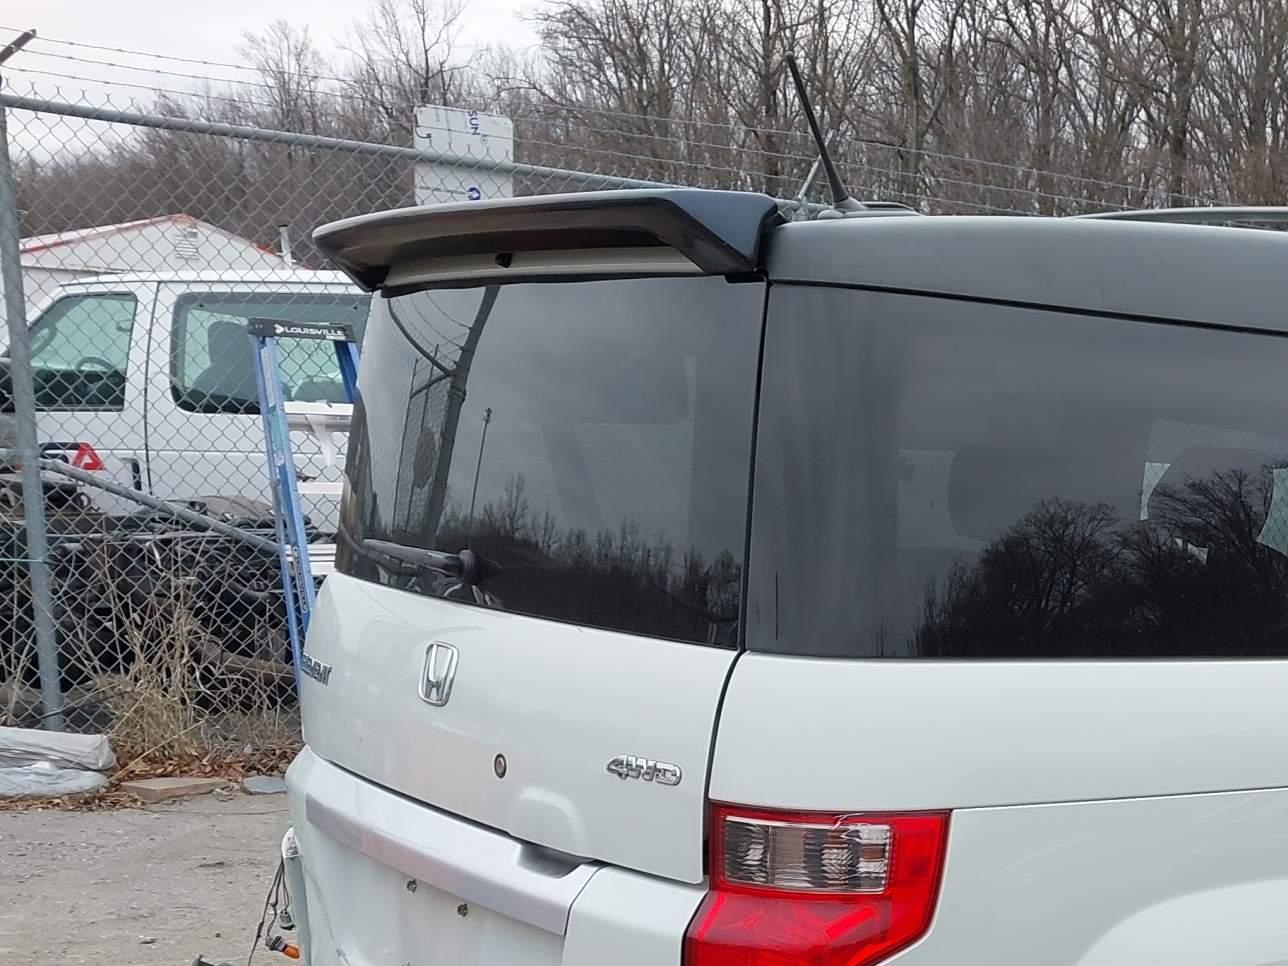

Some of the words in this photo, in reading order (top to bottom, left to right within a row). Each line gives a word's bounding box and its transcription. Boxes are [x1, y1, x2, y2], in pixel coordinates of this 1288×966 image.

[467, 110, 481, 136] SUN
[284, 325, 345, 337] LOUISVILLE
[606, 754, 682, 786] 4WD
